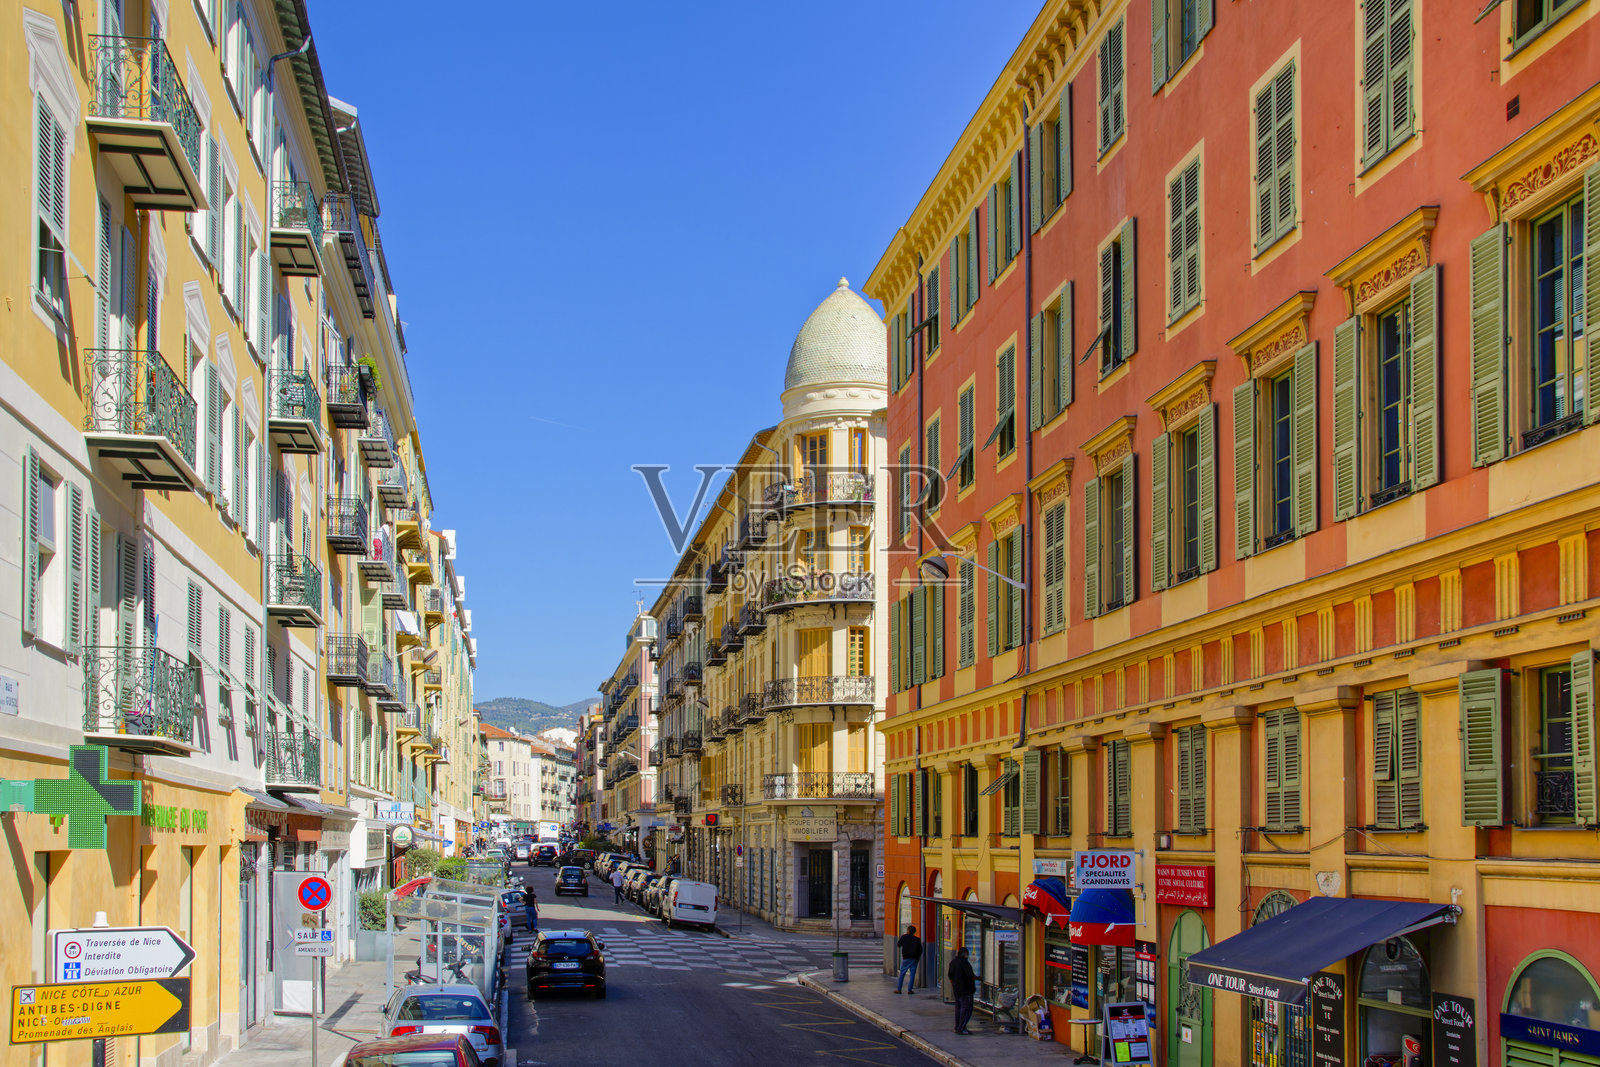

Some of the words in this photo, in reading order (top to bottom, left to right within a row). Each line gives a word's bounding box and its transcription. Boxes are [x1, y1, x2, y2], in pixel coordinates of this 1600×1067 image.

[380, 811, 413, 820] ATICA
[1080, 855, 1131, 868] FJORD
[1173, 879, 1185, 887] SOCIAL
[1186, 880, 1204, 888] CULTUREL
[86, 938, 126, 948] Traversée
[130, 938, 140, 946] de
[143, 937, 161, 946] Nice
[84, 952, 122, 961] Interdite
[84, 967, 125, 976] Déviation
[127, 965, 173, 975] Obligatoire
[1208, 972, 1224, 987] ONE
[1225, 974, 1246, 992] TOUR
[1248, 983, 1264, 996] Street
[1264, 986, 1280, 999] Food
[1312, 976, 1325, 994] ONE
[1325, 976, 1343, 1000] TOUR
[41, 989, 67, 1000] NICE
[72, 986, 100, 998] CÔTE
[18, 1001, 121, 1015] ANTIBES-DIGNE
[1433, 1001, 1450, 1020] ONE
[1450, 1000, 1474, 1029] TOUR
[1440, 1016, 1453, 1026] Street
[1453, 1018, 1465, 1028] Food
[17, 1027, 73, 1039] Promenade
[77, 1026, 93, 1035] des
[98, 1023, 133, 1034] Anglais
[1527, 1024, 1551, 1038] SAINT
[1553, 1029, 1580, 1044] JAMES
